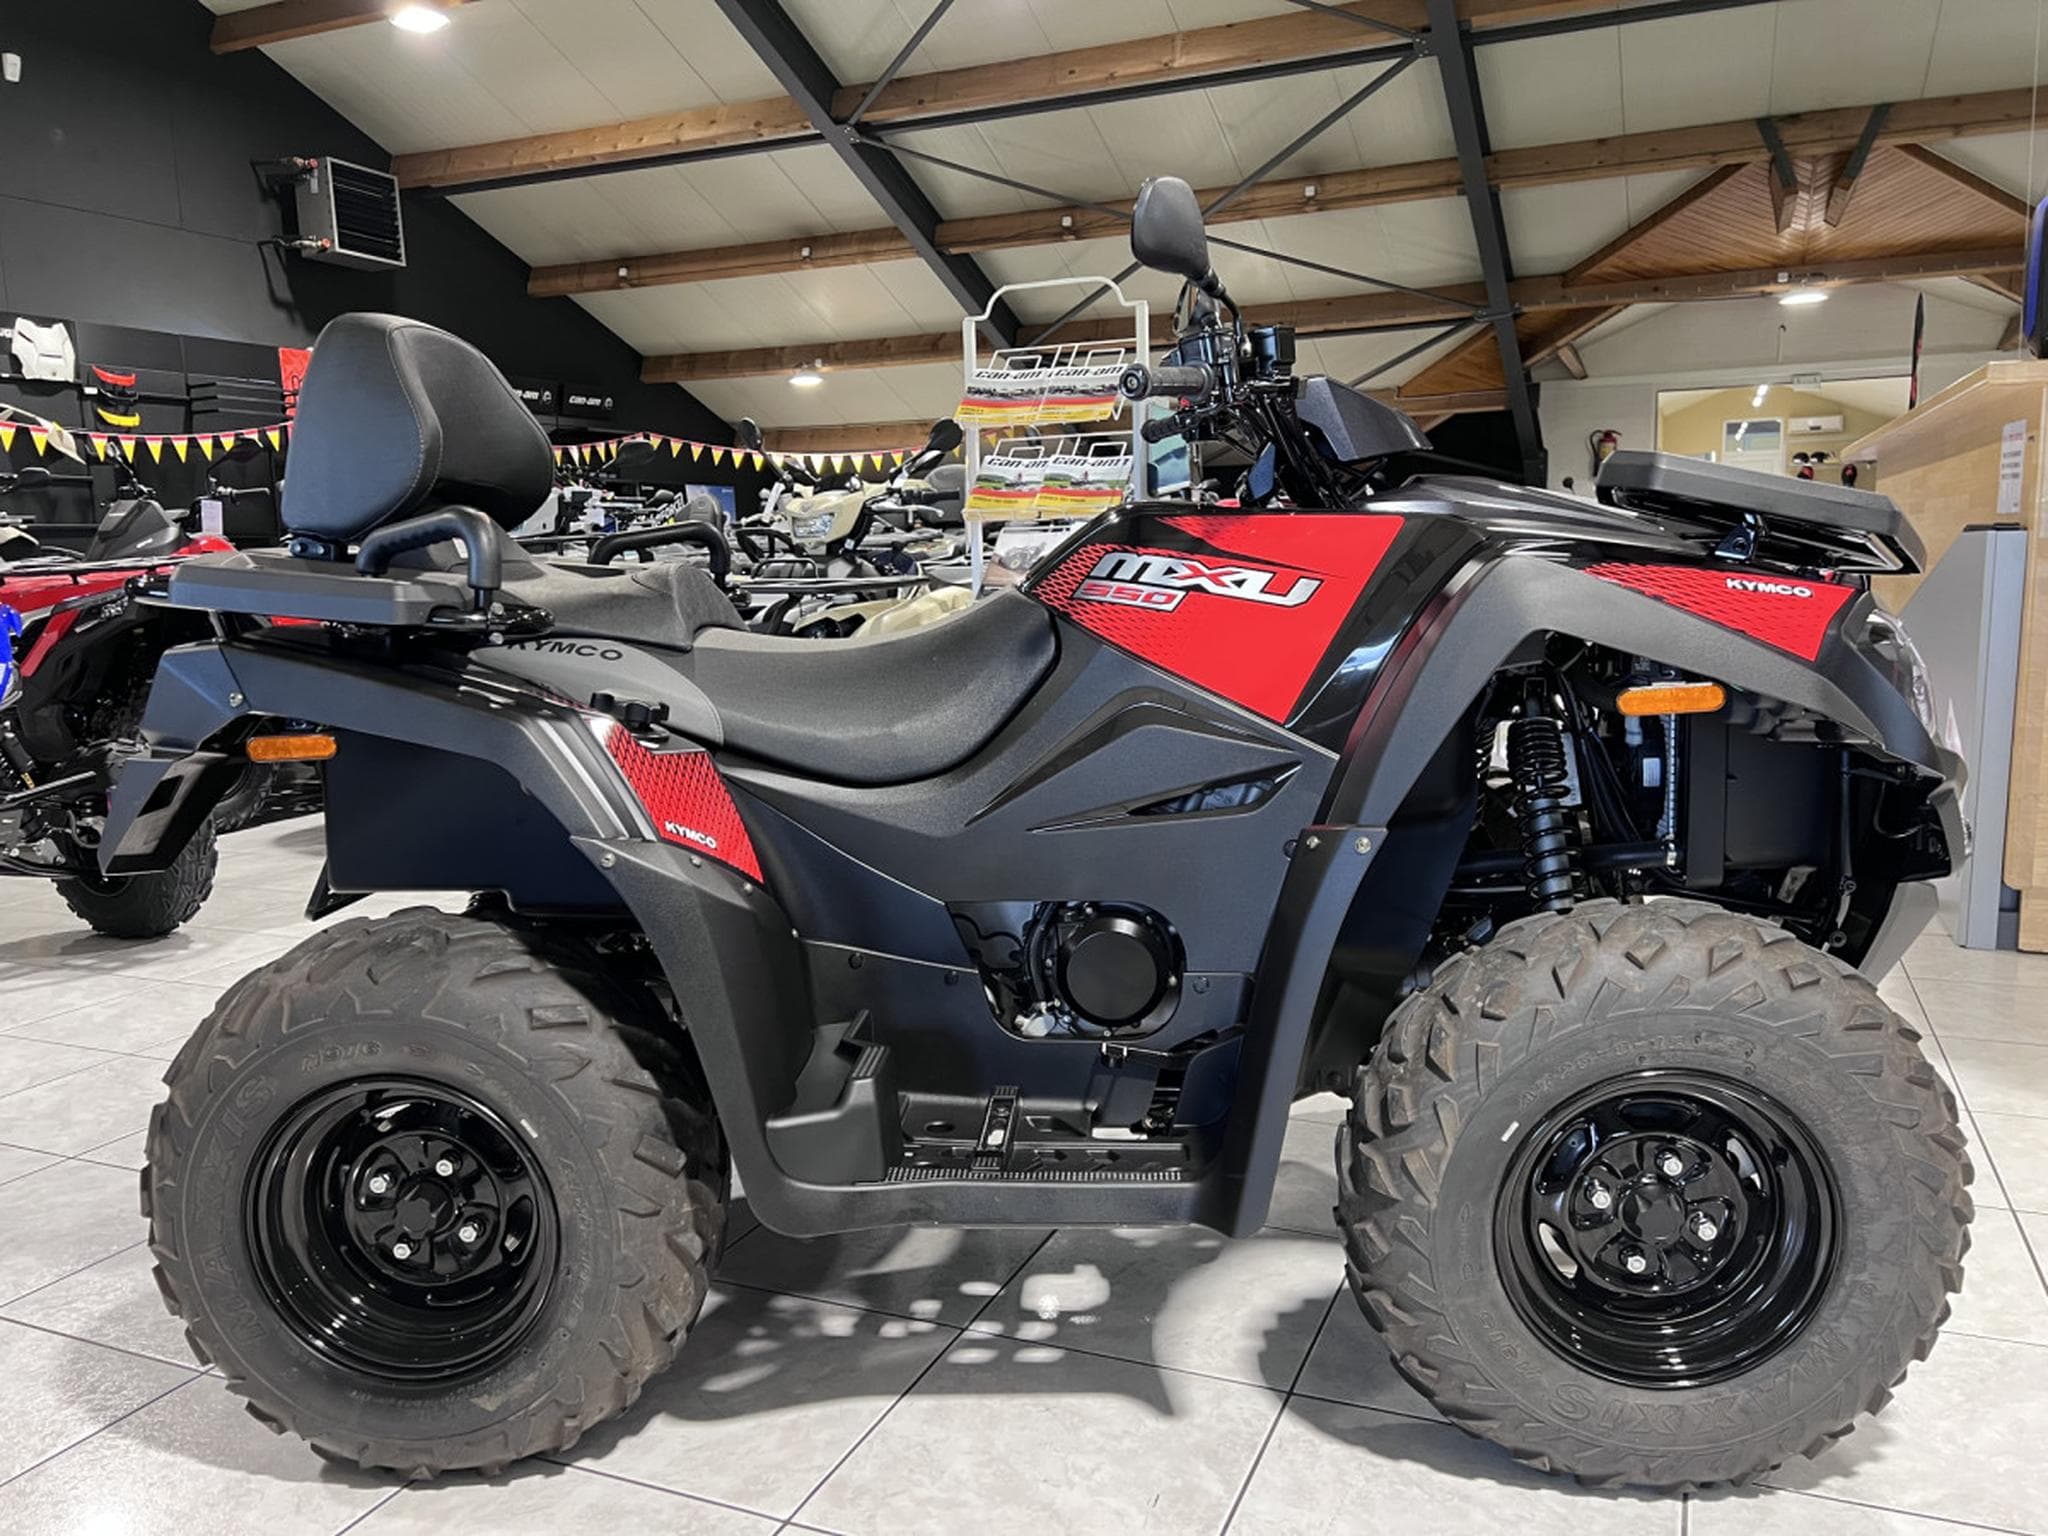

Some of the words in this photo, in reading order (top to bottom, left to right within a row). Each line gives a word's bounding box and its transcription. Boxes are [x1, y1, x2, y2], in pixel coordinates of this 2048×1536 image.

[1089, 552, 1324, 607] MXU
[1725, 578, 1813, 598] KYMCO
[1080, 581, 1177, 606] 550
[664, 820, 717, 849] KYMCO
